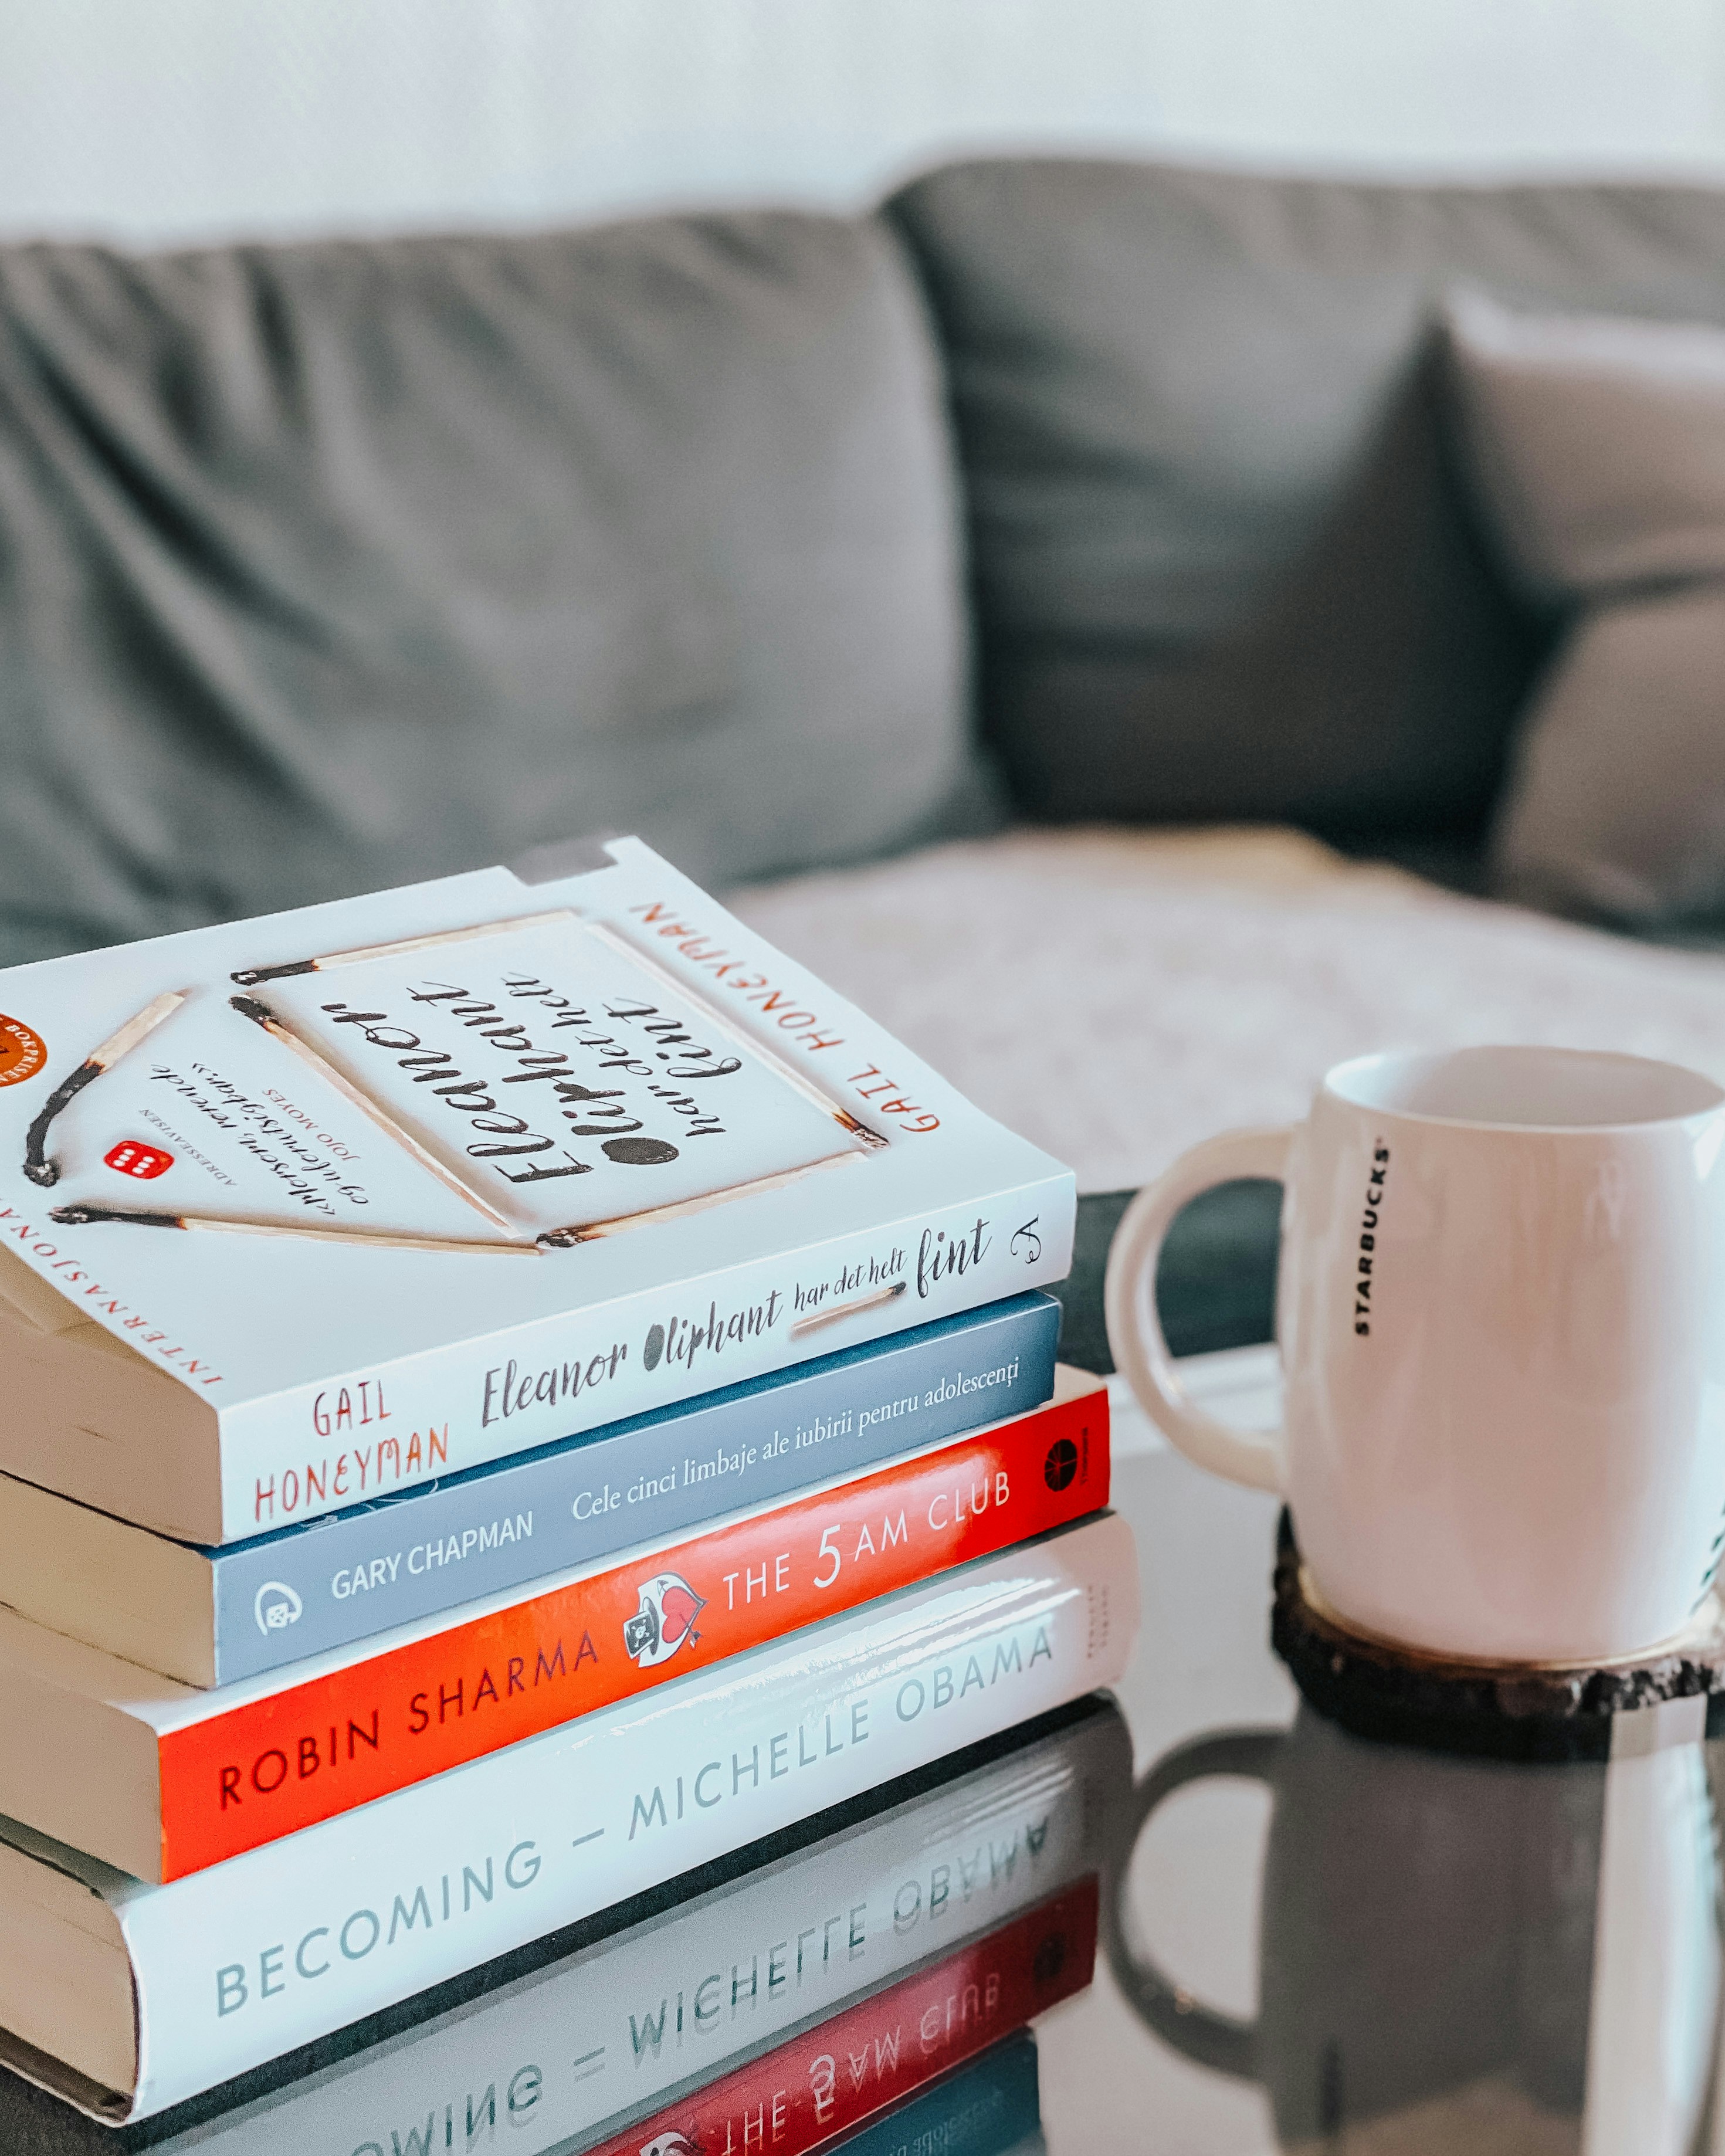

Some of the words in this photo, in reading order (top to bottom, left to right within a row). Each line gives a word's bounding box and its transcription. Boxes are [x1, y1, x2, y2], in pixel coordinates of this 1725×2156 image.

[500, 972, 592, 1028] helt
[628, 903, 845, 1050] HONEYMAN
[406, 981, 680, 1165] Oliphant
[575, 1030, 653, 1076] det
[602, 998, 742, 1078] fint
[262, 1089, 318, 1131] MOYES
[320, 1003, 594, 1182] Eleanor
[648, 1085, 727, 1137] har
[847, 1062, 940, 1132] GAIL
[139, 1108, 237, 1187] ADRESSEAVISEN
[316, 1134, 362, 1161] JOJO
[335, 1183, 368, 1204] og
[1355, 1148, 1390, 1337] STARBUCKS
[0, 1199, 223, 1385] INTERNASJONA
[482, 1343, 628, 1429] Eleanor
[643, 1290, 784, 1371] Oliphant
[794, 1281, 829, 1310] har
[835, 1265, 867, 1296] det
[869, 1248, 908, 1283] helt
[916, 1218, 993, 1298] fint
[313, 1379, 391, 1437] GAIL
[255, 1423, 449, 1523] HONEYMAN
[572, 1484, 621, 1520] Cele
[628, 1466, 676, 1504] cinci
[683, 1443, 757, 1486] limbaje
[762, 1431, 789, 1460] ale
[795, 1407, 853, 1450] iubirii
[858, 1395, 919, 1437] pentru
[331, 1551, 402, 1599] GARY
[407, 1511, 534, 1575] CHAPMAN
[723, 1552, 791, 1611] THE
[814, 1524, 841, 1589] 5
[853, 1509, 908, 1562] AM
[927, 1472, 1010, 1530] CLUB
[220, 1710, 379, 1809] ROBIN
[409, 1629, 599, 1734] SHARMA
[215, 1840, 541, 2018] BECOMING
[629, 1700, 869, 1840] MICHELLE
[896, 1627, 1052, 1722] OBAMA
